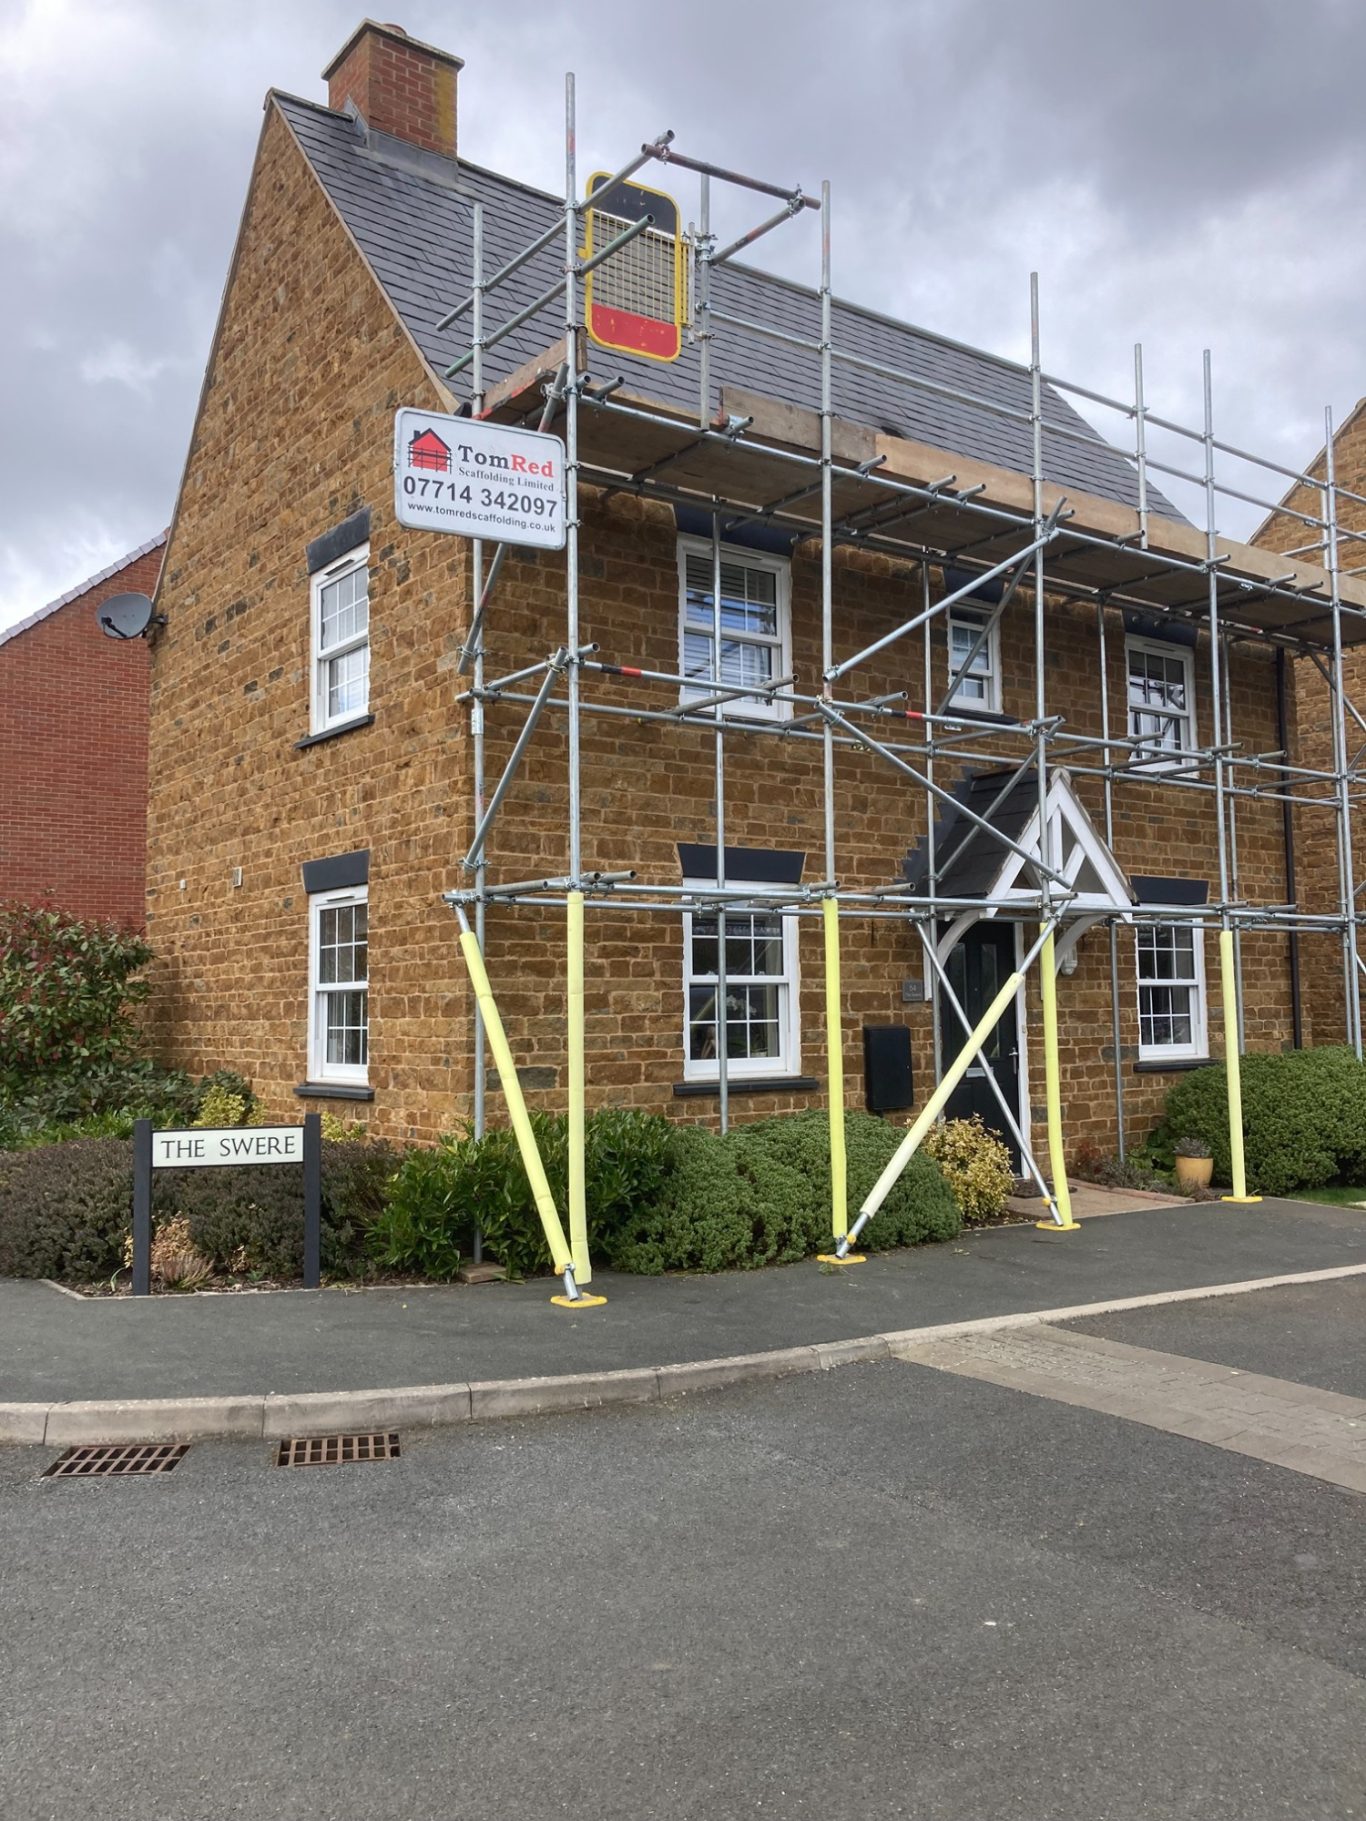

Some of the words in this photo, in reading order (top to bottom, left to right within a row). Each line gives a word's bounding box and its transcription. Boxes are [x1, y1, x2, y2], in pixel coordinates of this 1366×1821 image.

[458, 444, 554, 478] TomRed
[458, 467, 515, 486] Scaffolding
[517, 476, 554, 492] Limited
[403, 475, 472, 504] 07714
[480, 488, 558, 518] 342097
[407, 502, 556, 533] www.tomredscaffolding.co.uk
[160, 1139, 205, 1159] THE
[219, 1135, 296, 1158] SWERE
